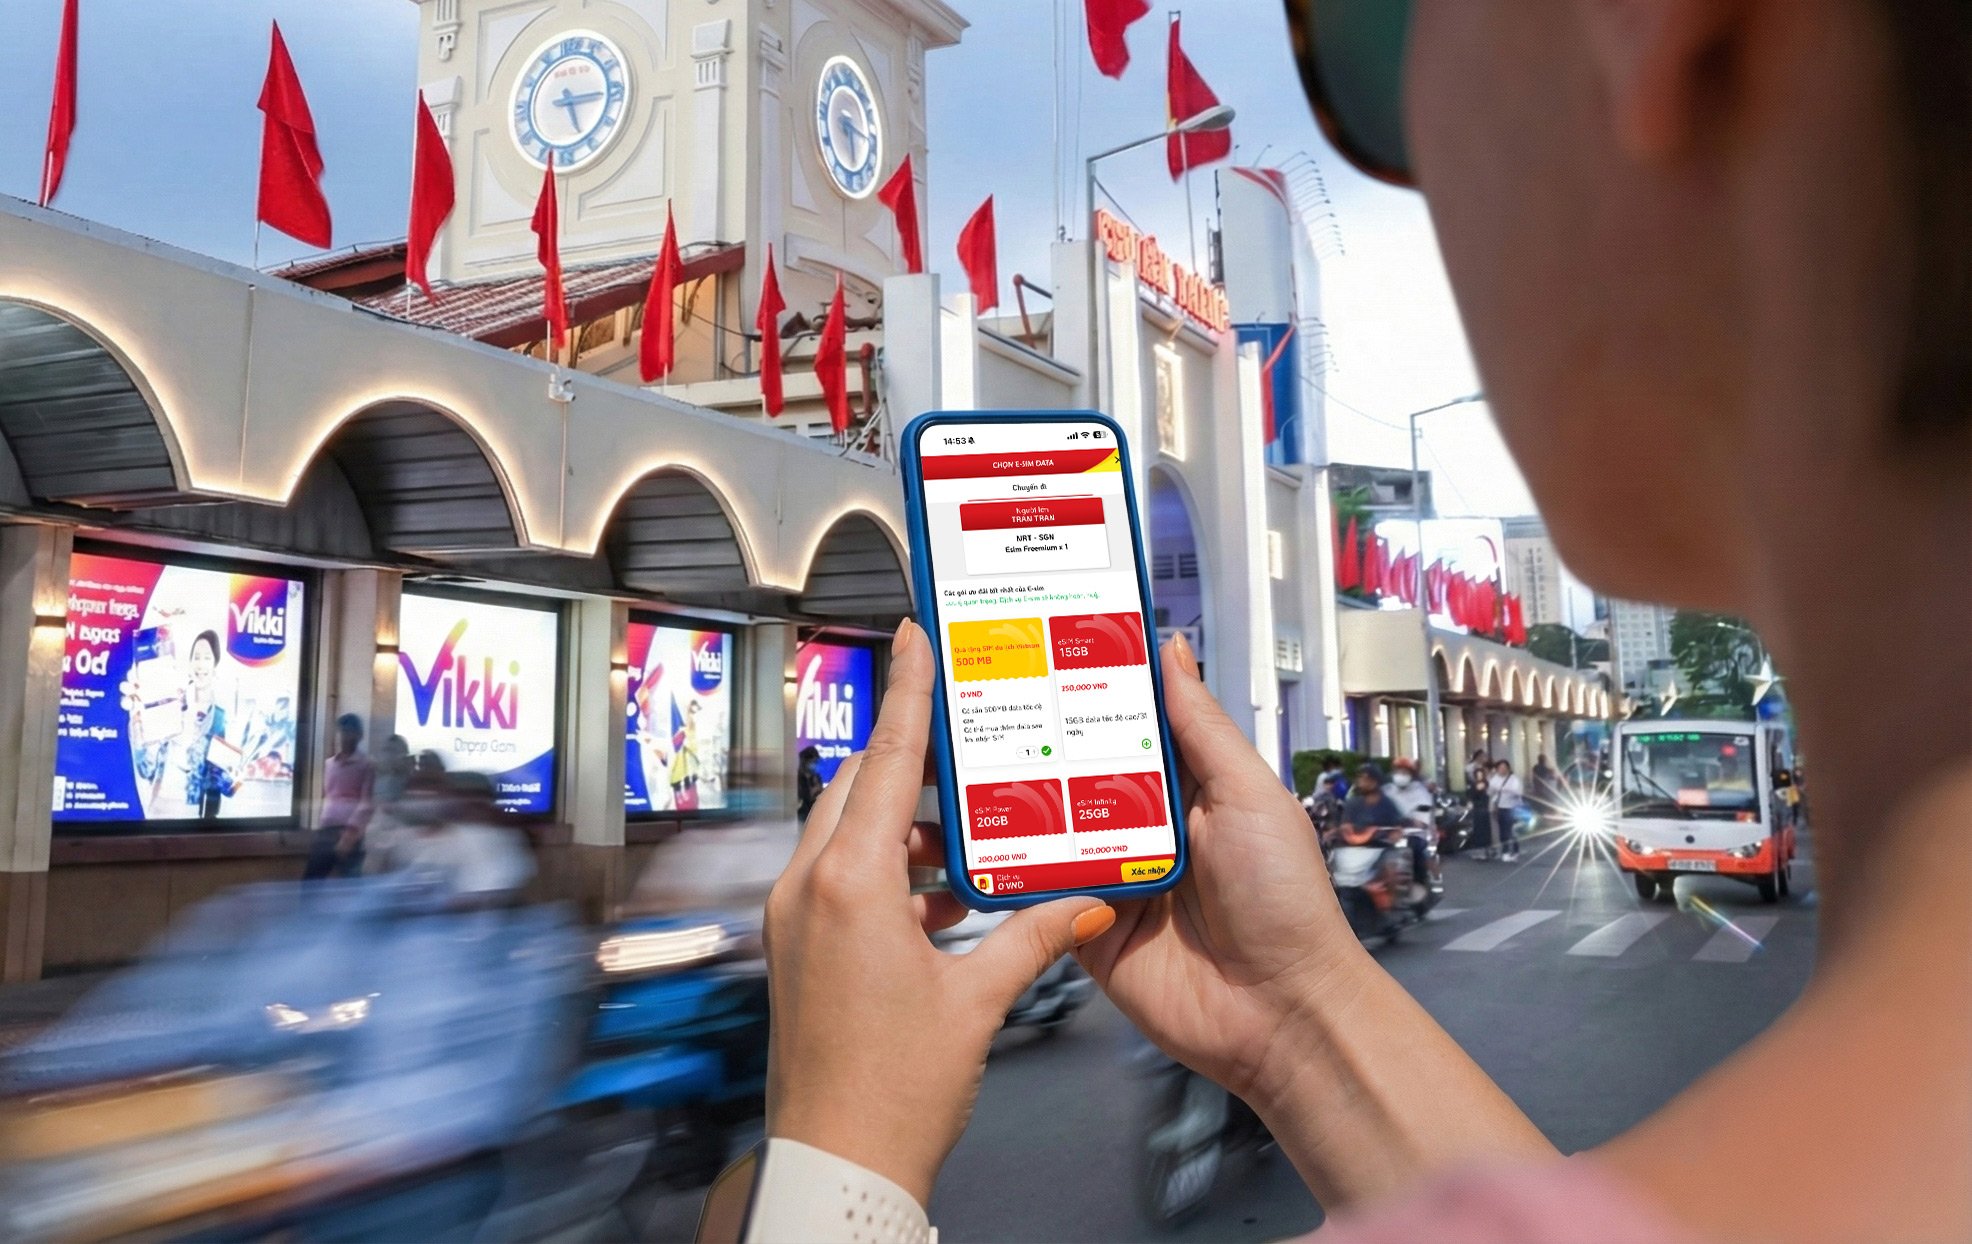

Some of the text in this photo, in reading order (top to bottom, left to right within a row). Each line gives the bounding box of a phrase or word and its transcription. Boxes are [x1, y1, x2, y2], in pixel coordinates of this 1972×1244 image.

[943, 437, 967, 445] 14:53
[992, 459, 1054, 469] CHỌN E-SIM DATA
[1012, 482, 1038, 492] Chuyến
[1016, 534, 1032, 542] NRT
[231, 591, 285, 637] Vikki
[1059, 646, 1089, 657] 15GB
[956, 656, 992, 666] 500 MB
[398, 618, 519, 730] Vikki
[1092, 682, 1108, 690] VND
[796, 654, 854, 740] Vikki
[967, 690, 982, 698] VND
[1079, 808, 1110, 820] 25GB
[976, 815, 1008, 828] 20GB
[1081, 846, 1111, 855] 250,000
[1132, 868, 1146, 876] Xác
[1006, 881, 1024, 889] VND
